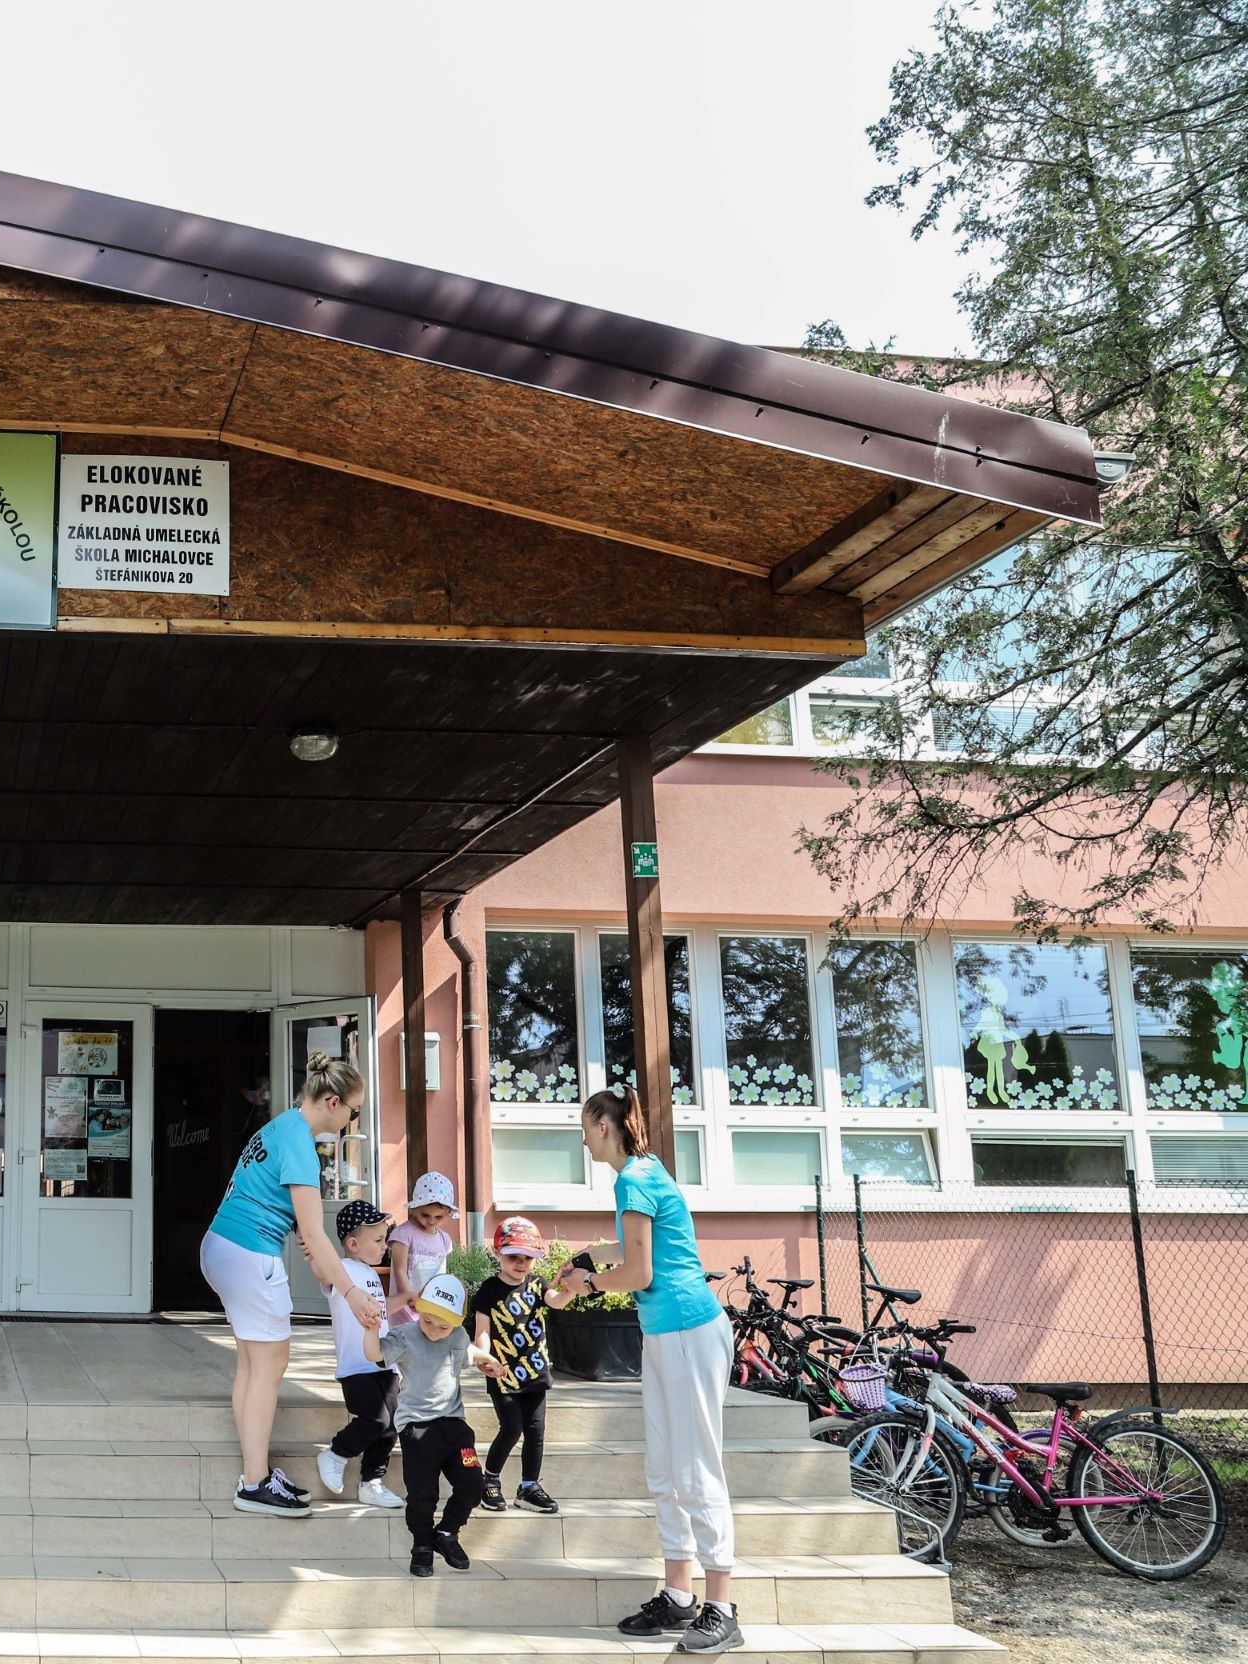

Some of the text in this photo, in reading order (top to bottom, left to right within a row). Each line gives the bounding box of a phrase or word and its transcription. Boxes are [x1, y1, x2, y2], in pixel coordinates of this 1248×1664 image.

[87, 465, 202, 487] ELOKOVANÉ
[80, 494, 209, 517] PRACOVISKO
[67, 523, 221, 545] ZÁKLADNÁ UMELECKÁ
[74, 545, 214, 566] ŠKOLA MICHALOVCE
[95, 567, 194, 584] ŠTEFÁNIKOVA 20
[167, 1119, 210, 1147] Welcome
